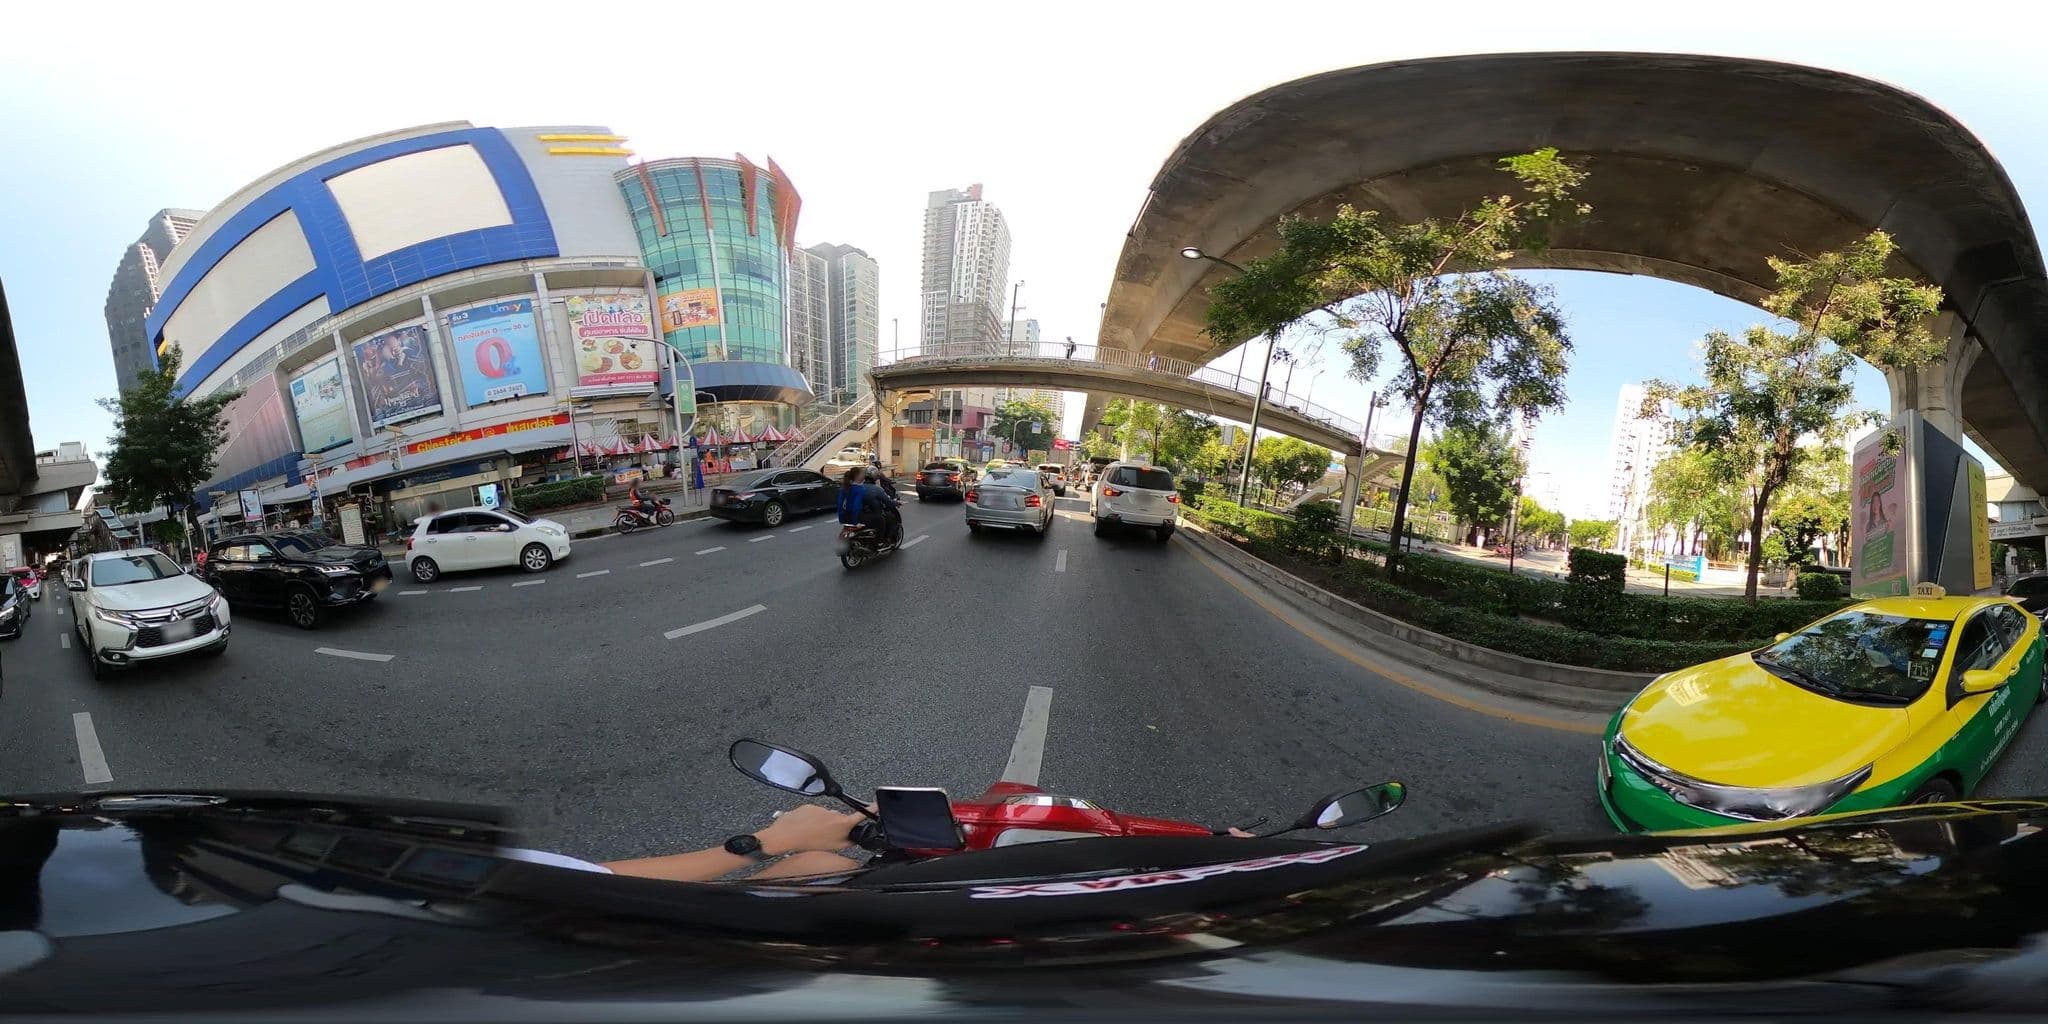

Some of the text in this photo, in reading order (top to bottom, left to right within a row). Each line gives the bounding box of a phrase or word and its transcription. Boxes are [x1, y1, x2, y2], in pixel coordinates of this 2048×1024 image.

[582, 308, 644, 327] เปิดแล้ว
[416, 435, 472, 453] Chester's
[1917, 586, 1933, 596] TAXI
